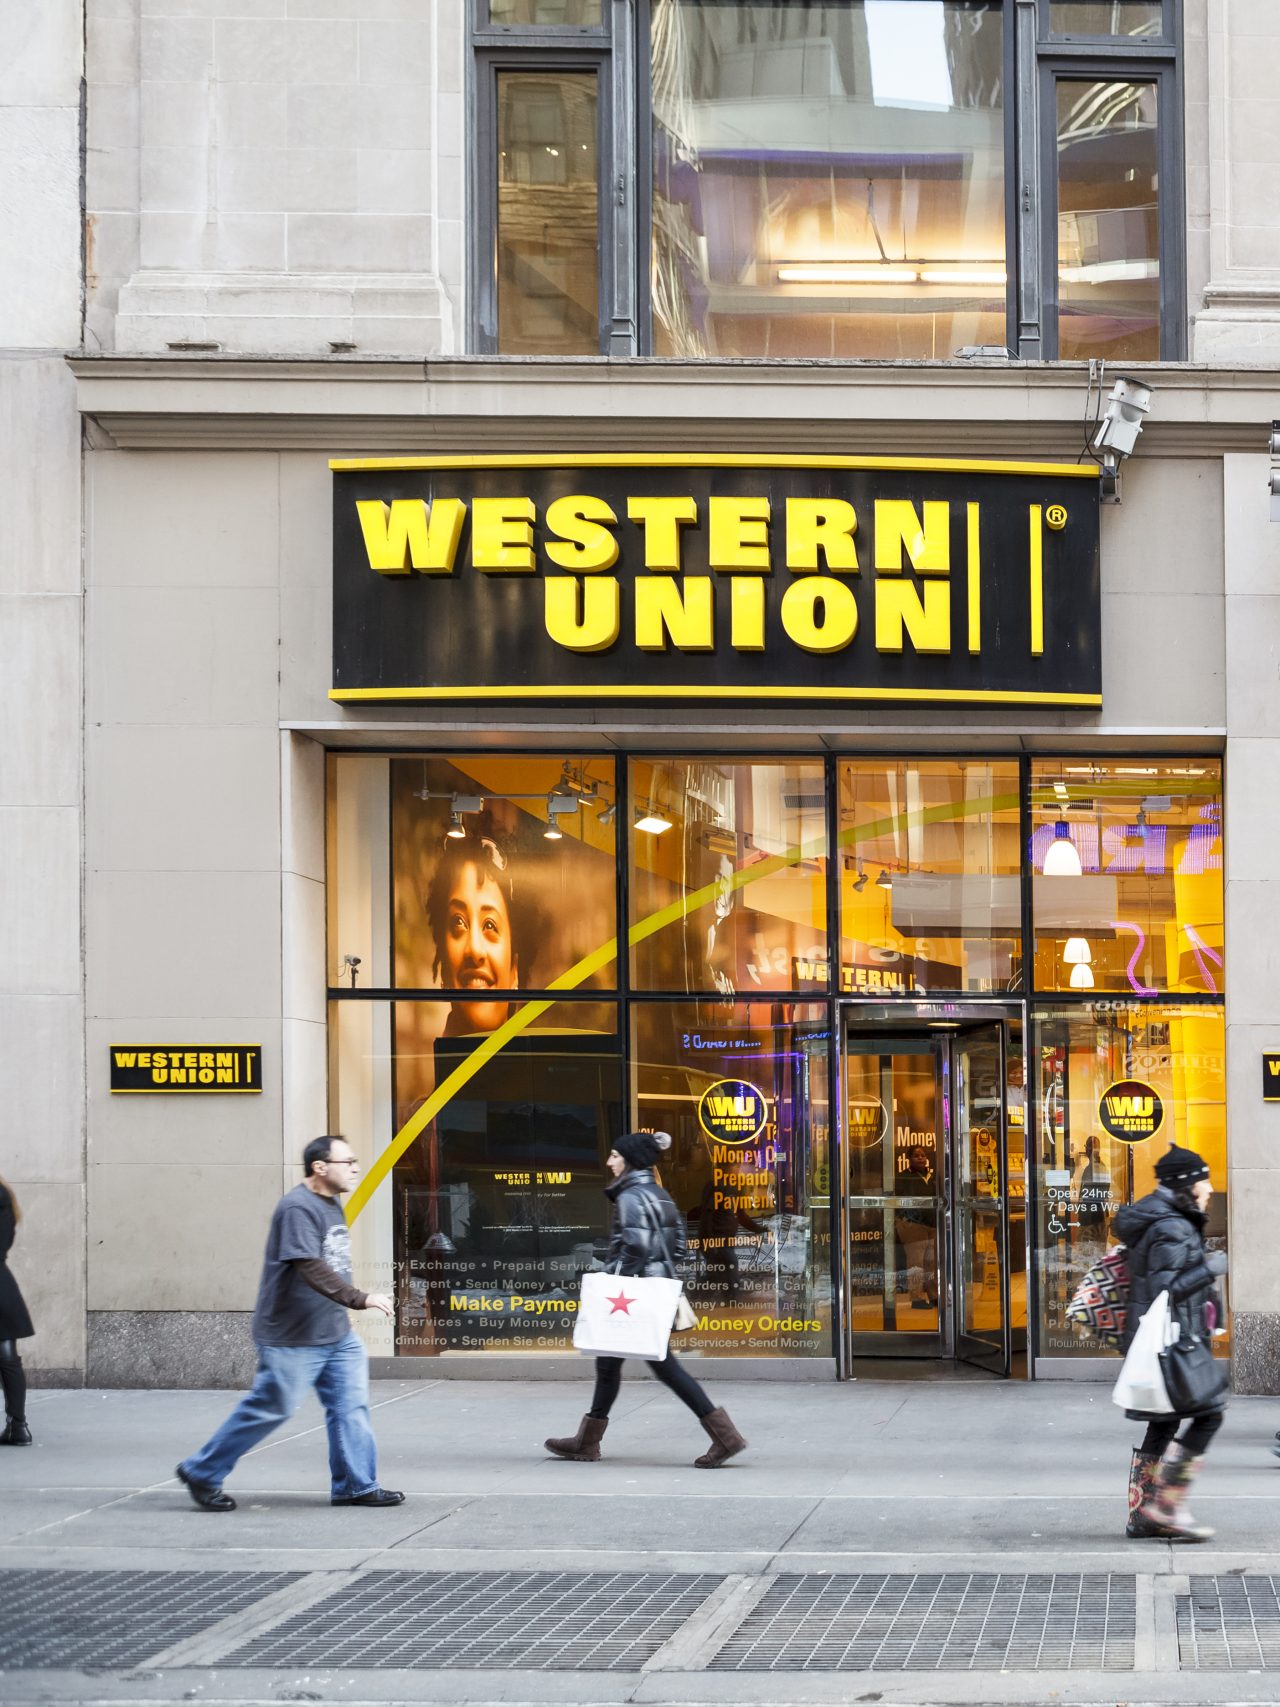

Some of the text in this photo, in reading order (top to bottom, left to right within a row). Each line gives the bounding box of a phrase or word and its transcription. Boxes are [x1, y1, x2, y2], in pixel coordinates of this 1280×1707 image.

[355, 495, 950, 575] WESTERN
[545, 576, 951, 653] UNION
[115, 1052, 233, 1068] WESTERN
[152, 1068, 233, 1083] UNION
[707, 1096, 755, 1117] WU
[1106, 1096, 1154, 1117] WU
[712, 1118, 755, 1126] WESTERN
[713, 1146, 761, 1168] Money
[713, 1168, 769, 1191] Prepaid
[1047, 1188, 1114, 1200] Open 24hrs
[1047, 1202, 1120, 1214] 7 Days a We
[702, 1236, 726, 1251] your
[728, 1234, 764, 1248] money.
[410, 1260, 476, 1273] Exchange
[493, 1260, 545, 1273] Prepaid
[550, 1260, 594, 1272] Servic
[689, 1262, 726, 1272] dinero
[401, 1278, 451, 1291] l'argent
[465, 1278, 498, 1290] Send
[502, 1279, 545, 1291] Money
[686, 1281, 729, 1291] Orders
[450, 1295, 504, 1312] Make
[690, 1300, 717, 1311] oney
[401, 1317, 462, 1328] Services
[479, 1317, 505, 1329] Buy
[510, 1317, 556, 1330] Money
[757, 1315, 822, 1332] Orders
[395, 1335, 448, 1346] dinheiro
[461, 1336, 504, 1347] Senden
[510, 1336, 533, 1347] Sie
[537, 1336, 566, 1347] Geld
[688, 1338, 739, 1349] Services
[748, 1338, 778, 1349] Send
[780, 1338, 820, 1351] Money
